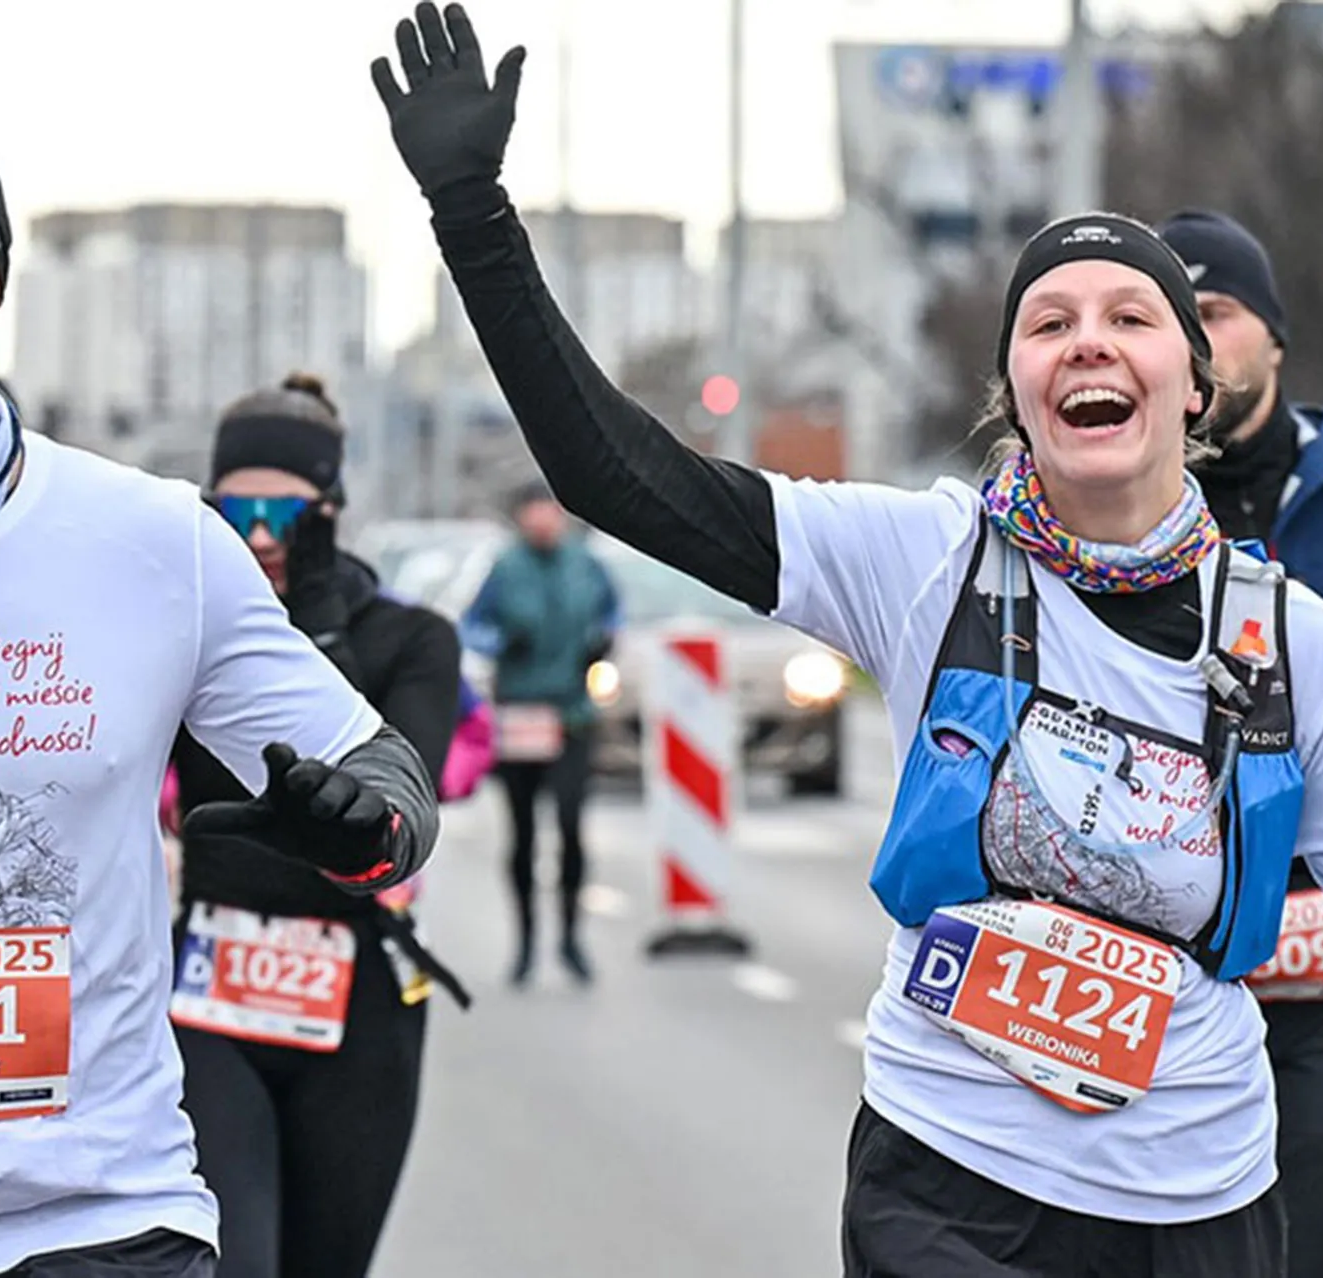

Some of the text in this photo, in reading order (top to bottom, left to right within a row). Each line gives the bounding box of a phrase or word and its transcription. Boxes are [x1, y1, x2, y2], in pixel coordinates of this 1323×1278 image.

[6, 674, 93, 707] mieście
[1045, 933, 1069, 953] 04
[1050, 918, 1074, 938] 06
[225, 945, 335, 1002] 1022
[919, 947, 960, 989] D
[1077, 931, 1169, 985] 2025
[987, 949, 1153, 1050] 1124
[1007, 1021, 1100, 1069] WERONIKA
